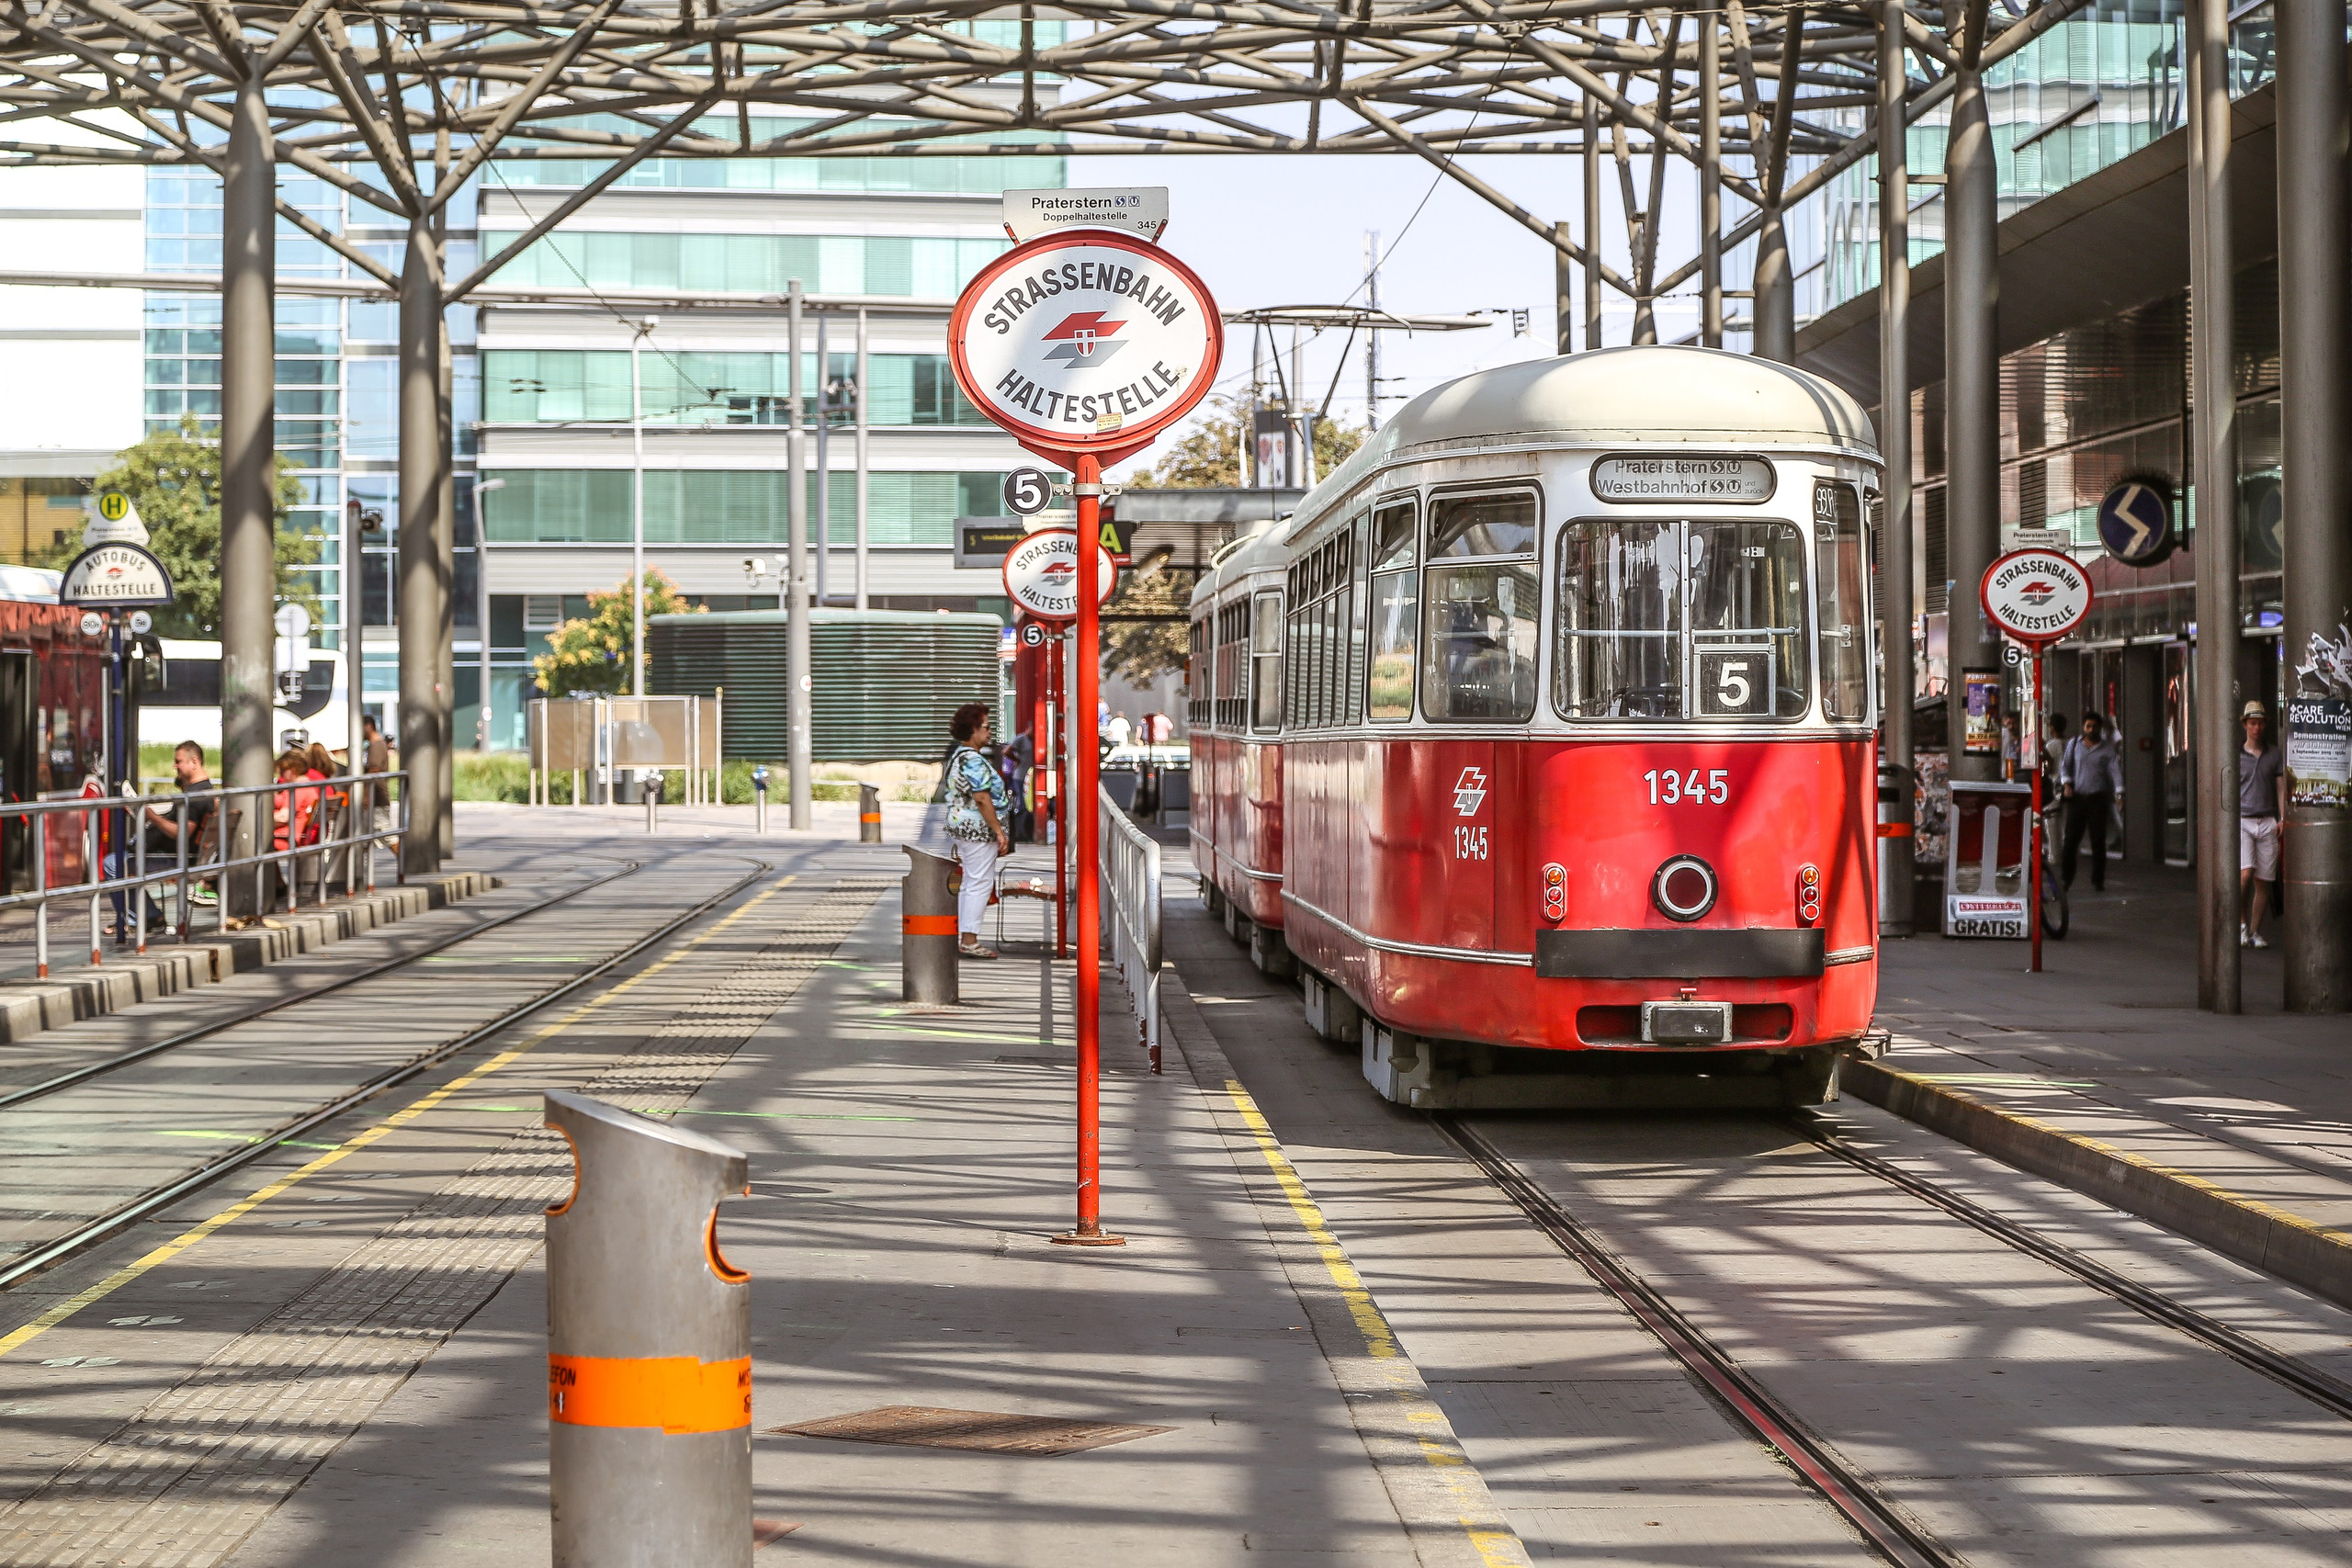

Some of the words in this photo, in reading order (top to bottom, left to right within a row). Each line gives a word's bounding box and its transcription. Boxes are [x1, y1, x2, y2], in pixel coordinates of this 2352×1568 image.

[1032, 197, 1112, 209] Praterstern
[1043, 211, 1127, 222] Doppelhaltestelle
[1137, 220, 1157, 230] 345
[984, 262, 1185, 335] STRASSENBAHN
[995, 360, 1181, 423] HALTESTELLE
[1615, 460, 1708, 474] Praterstern
[1014, 473, 1042, 509] 5
[1598, 479, 1708, 494] Westbahnhof
[107, 497, 121, 514] H
[85, 552, 146, 572] AUTOBUS
[1996, 560, 2080, 592] STRASSENBAHN
[73, 583, 157, 597] HALTESTELLE
[1999, 603, 2076, 629] HALTESTELLE
[1027, 627, 1038, 646] 5
[2007, 649, 2018, 664] 5
[1717, 661, 1750, 707] 5
[2297, 705, 2324, 715] CARE
[2290, 714, 2351, 725] REVOLUTION
[2293, 731, 2346, 741] Demonstration
[1643, 769, 1728, 805] 1345
[1453, 825, 1488, 861] 1345
[1954, 919, 2021, 935] GRATIS!
